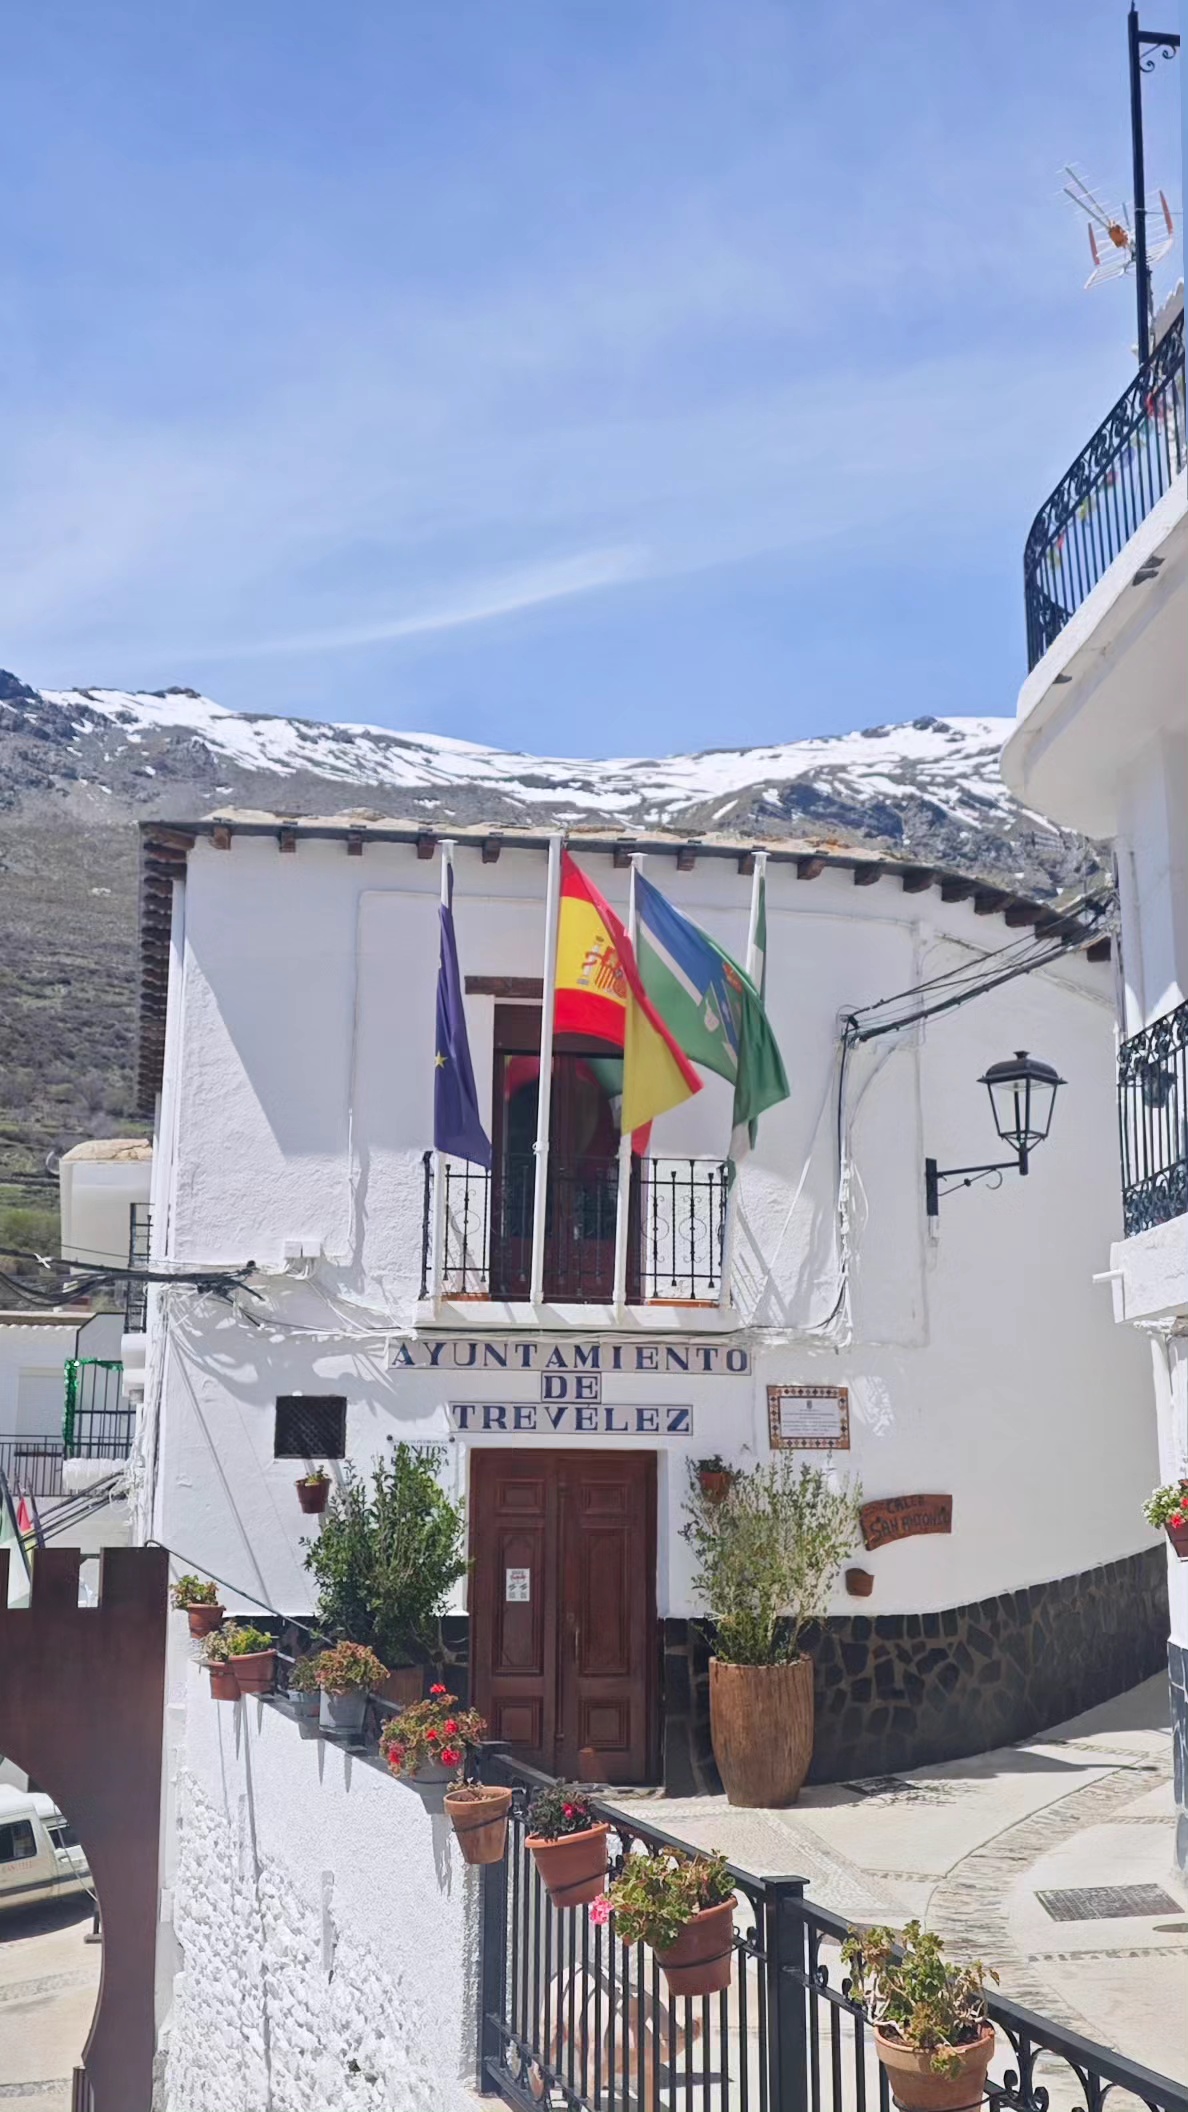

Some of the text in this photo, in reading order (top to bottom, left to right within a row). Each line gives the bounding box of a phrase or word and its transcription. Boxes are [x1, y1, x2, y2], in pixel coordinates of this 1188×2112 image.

[391, 1341, 748, 1372] AYUNTAMIENTO
[543, 1375, 599, 1400] DE
[452, 1403, 690, 1432] TREVÉLEZ
[870, 1516, 900, 1537] SAN
